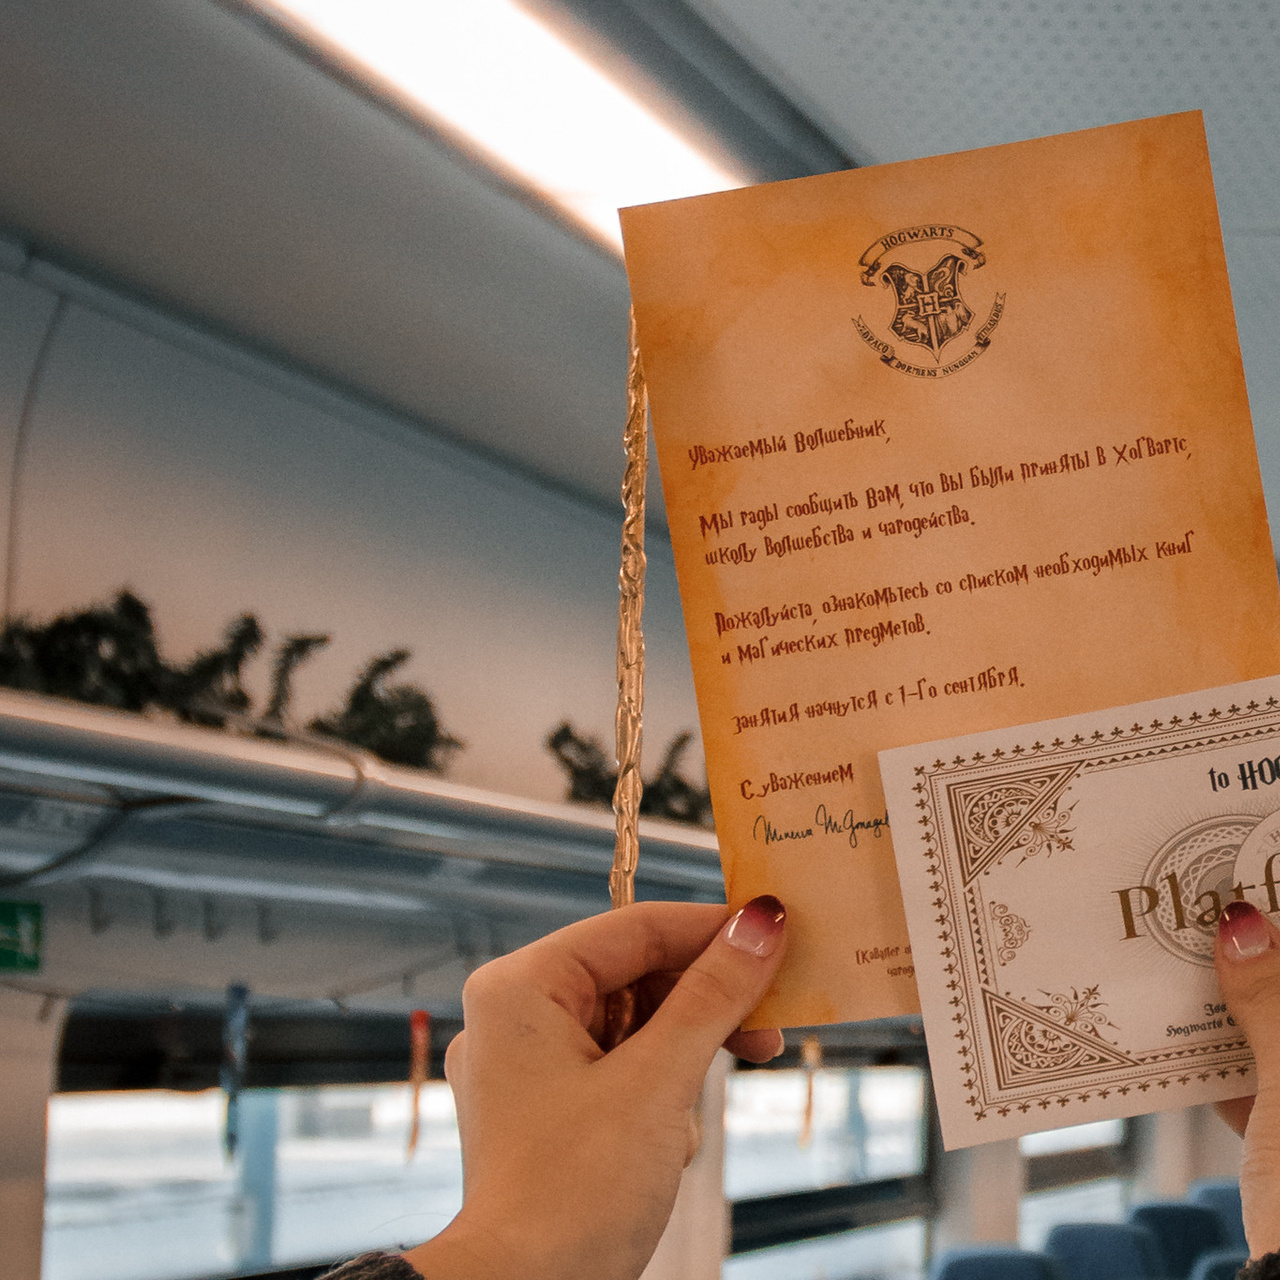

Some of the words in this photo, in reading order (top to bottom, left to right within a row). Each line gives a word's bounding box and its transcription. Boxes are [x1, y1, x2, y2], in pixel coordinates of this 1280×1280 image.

[880, 226, 955, 250] HOGWARTS
[699, 510, 733, 539] Мы
[1207, 766, 1230, 793] to
[1166, 1018, 1223, 1038] Hogwarts
